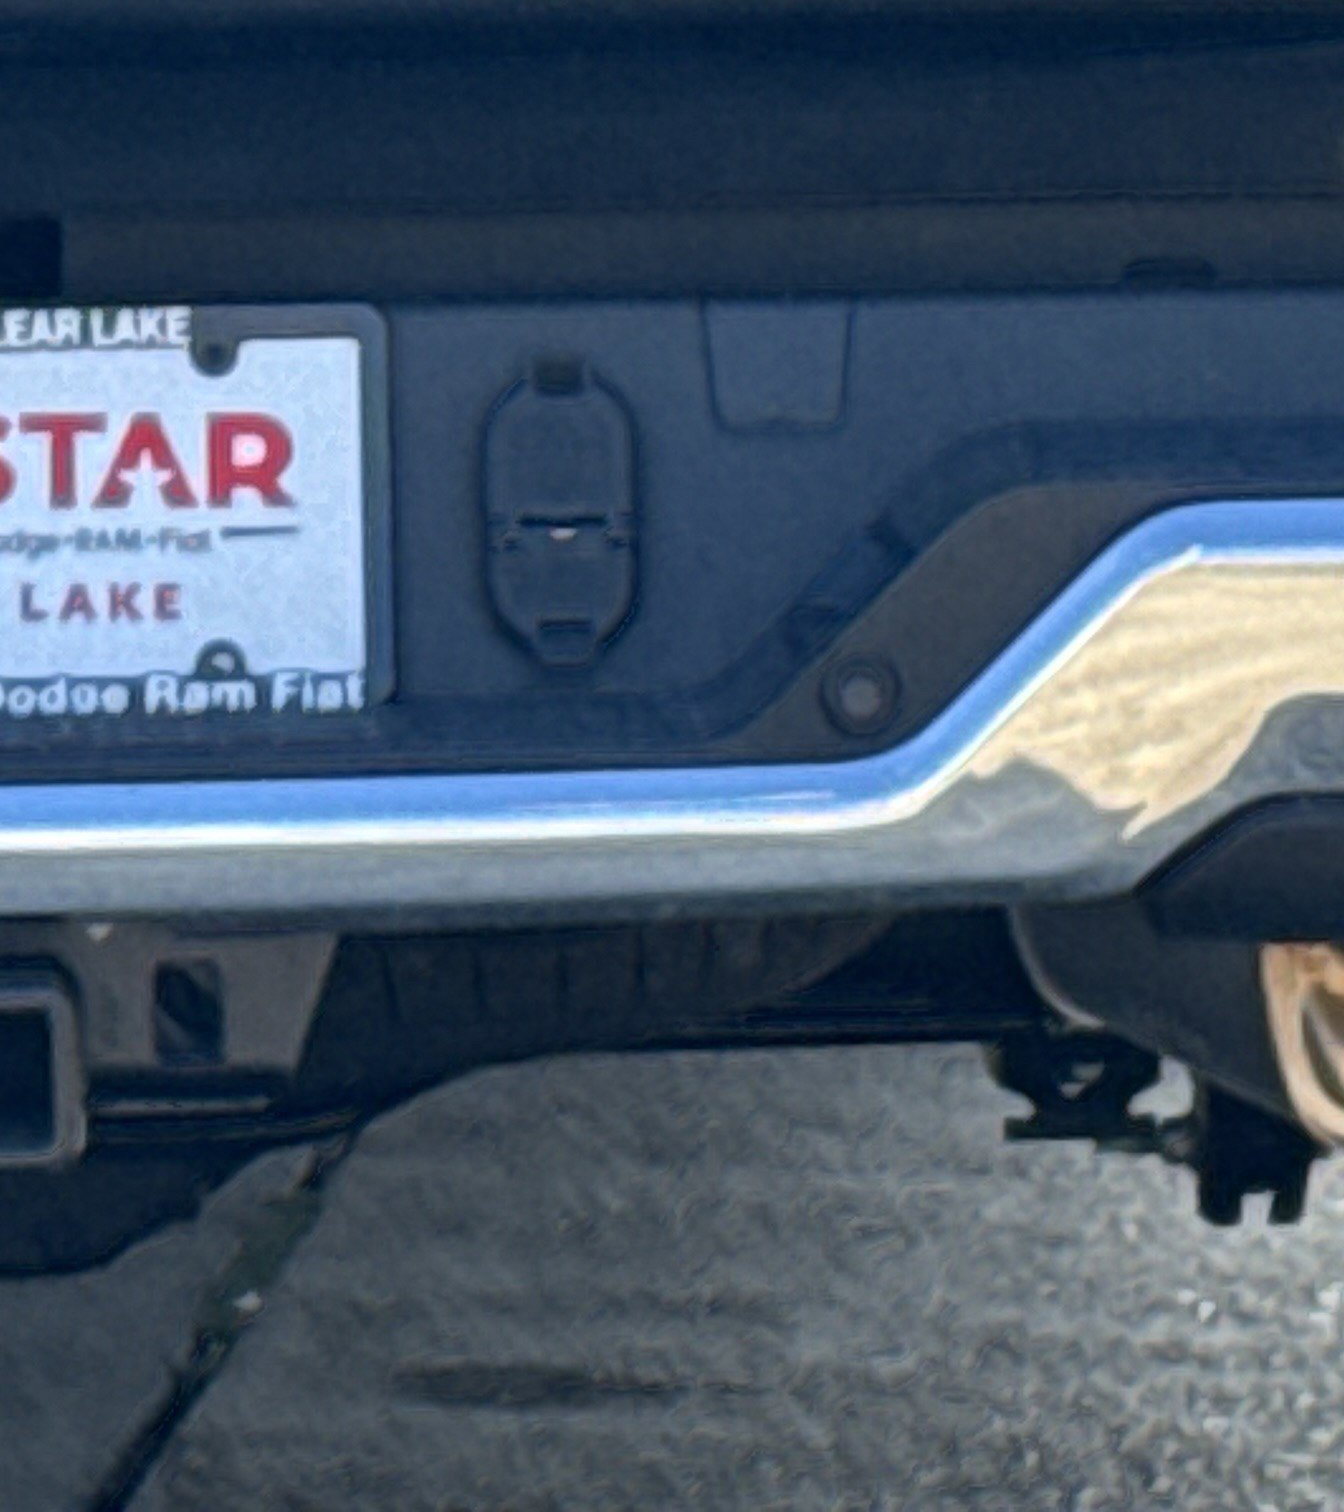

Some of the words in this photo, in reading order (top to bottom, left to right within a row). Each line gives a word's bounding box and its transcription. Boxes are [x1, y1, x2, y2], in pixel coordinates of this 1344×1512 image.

[89, 305, 193, 346] LAKE
[19, 581, 186, 622] LAKE
[145, 672, 258, 715] Ram
[270, 669, 366, 714] Fiat
